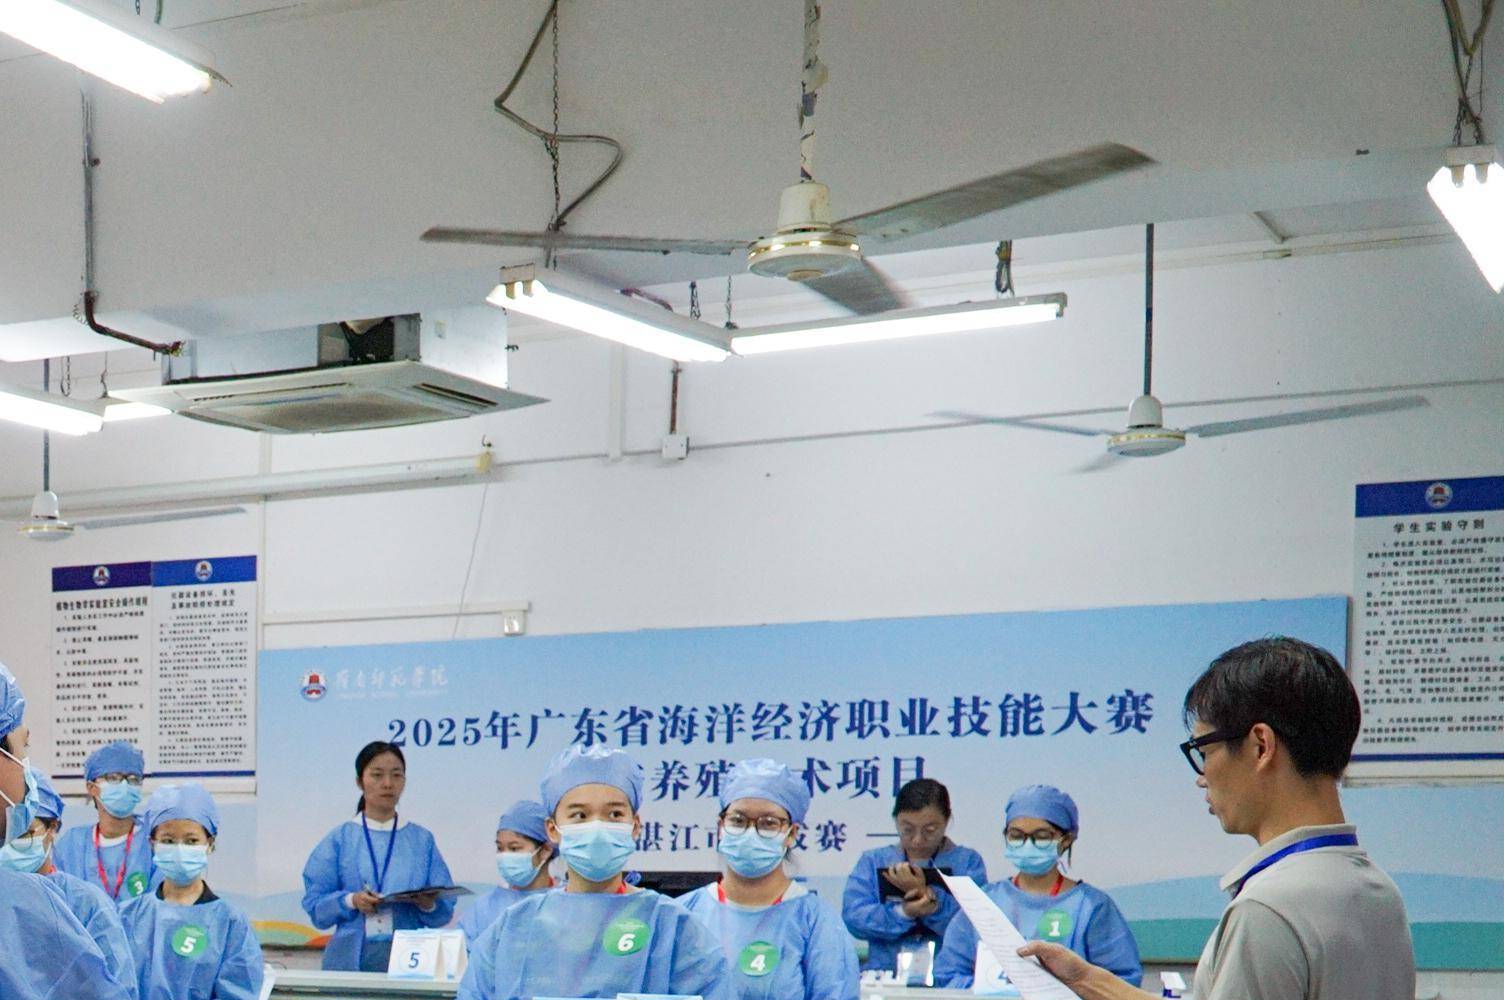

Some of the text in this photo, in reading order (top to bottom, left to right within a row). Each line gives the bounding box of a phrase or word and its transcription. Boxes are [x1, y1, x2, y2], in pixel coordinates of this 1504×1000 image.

[388, 688, 1155, 749] 2025年广东省海洋经济职业技能大赛
[1048, 920, 1061, 937] 1
[180, 936, 197, 953] 5
[617, 933, 636, 951] 6
[408, 952, 420, 968] 5
[750, 954, 766, 972] 4
